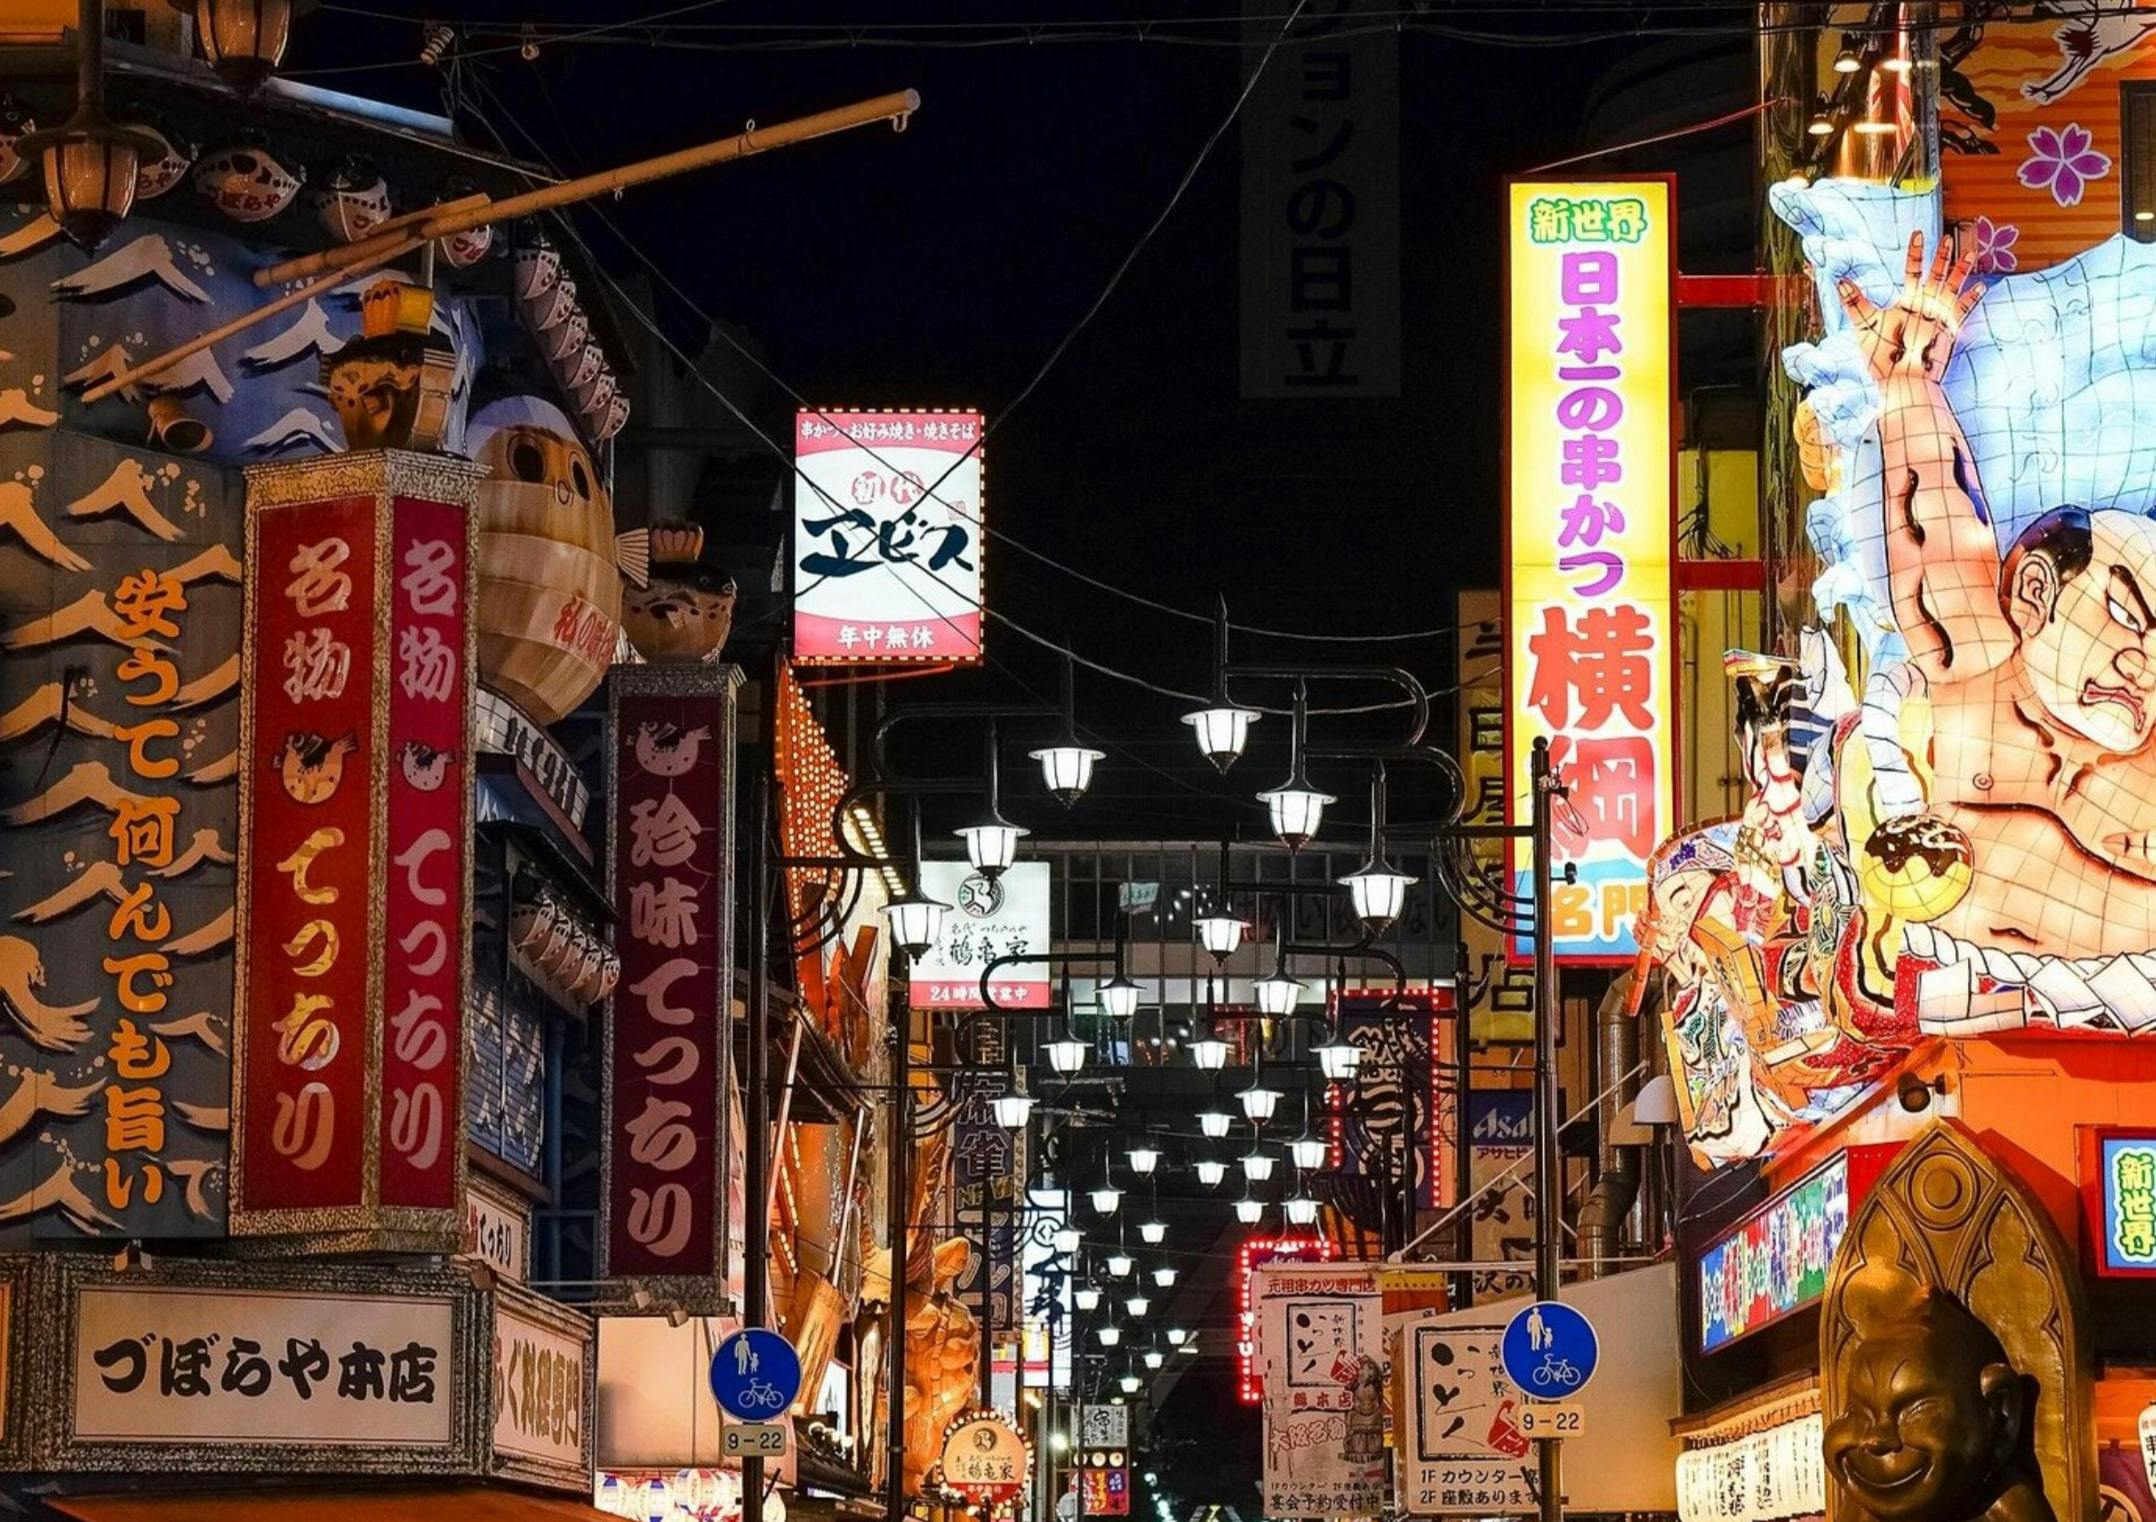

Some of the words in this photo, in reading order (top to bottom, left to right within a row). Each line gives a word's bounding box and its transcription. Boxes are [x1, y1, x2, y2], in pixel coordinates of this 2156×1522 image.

[1530, 198, 1648, 243] 新世界
[1556, 252, 1626, 596] 日本一の串かつ
[283, 537, 351, 703] 名物
[398, 538, 458, 703] 名物
[838, 624, 935, 649] 年中無休
[1528, 604, 1655, 863] 横綱
[103, 568, 187, 1210] 安うて何んでも旨い
[272, 826, 345, 1171] てっちり
[389, 826, 453, 1171] てっちり
[624, 792, 702, 1258] 珍味てっちり
[1267, 1276, 1376, 1294] 元祖串カツ専門店
[2118, 1153, 2155, 1257] 新世界
[93, 1331, 438, 1404] づぼらや本店
[1272, 1493, 1380, 1511] 宴会予約受付中
[1421, 1470, 1436, 1483] 1F
